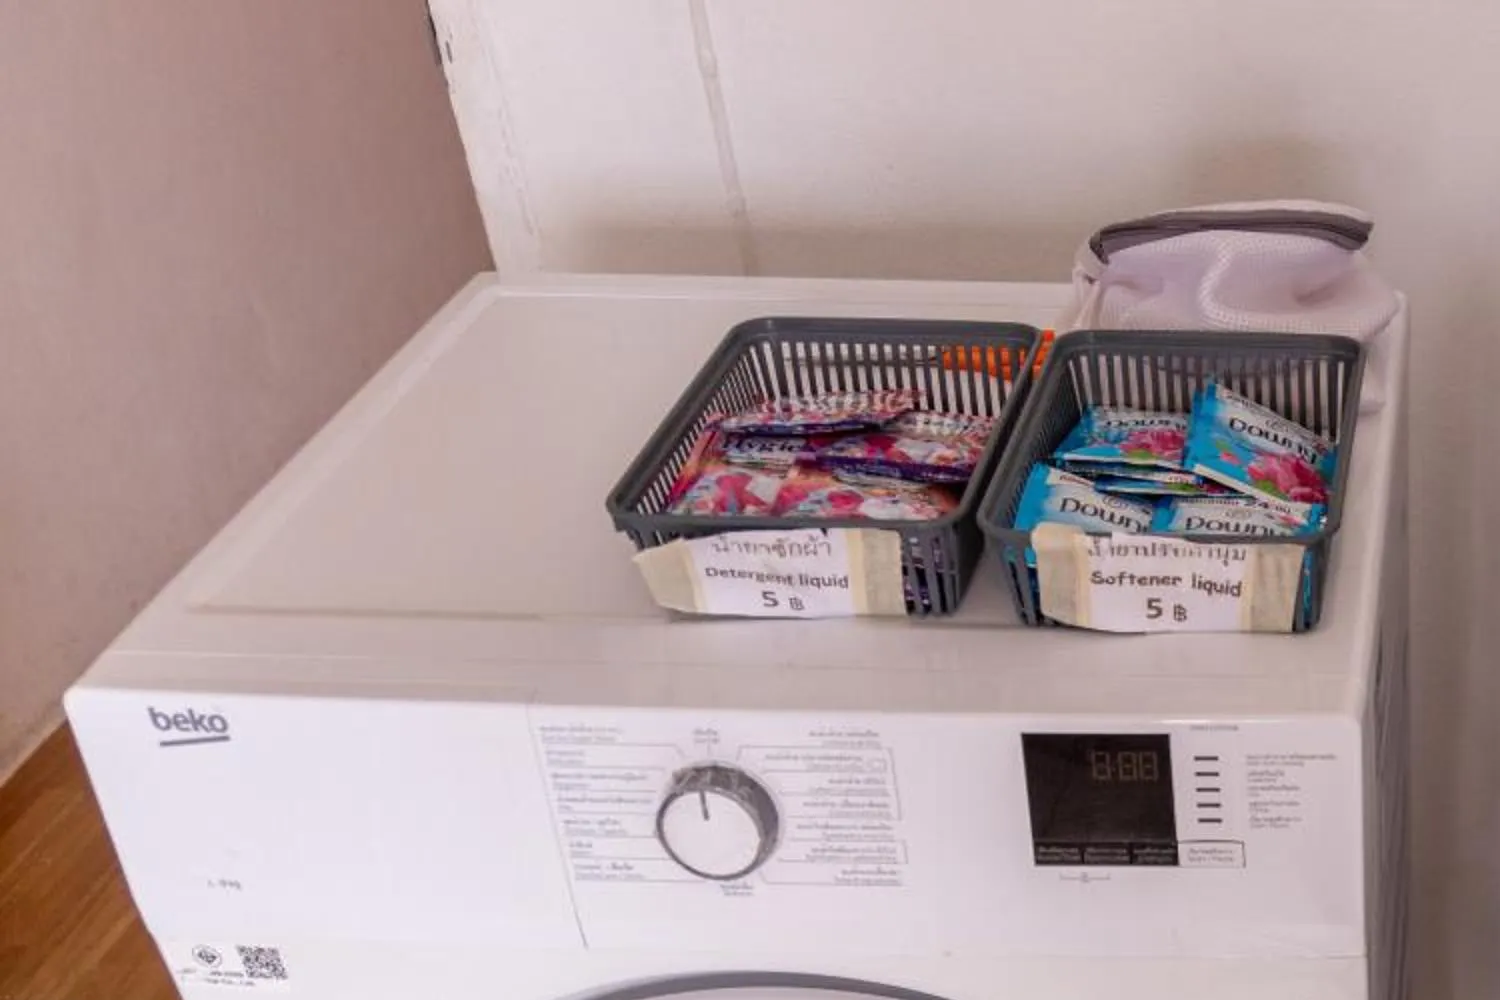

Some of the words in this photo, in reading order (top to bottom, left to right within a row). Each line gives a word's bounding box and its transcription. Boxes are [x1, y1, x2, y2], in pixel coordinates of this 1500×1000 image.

[705, 566, 796, 588] Detergent
[799, 573, 849, 589] liquid
[1090, 571, 1182, 586] Softener
[1191, 573, 1242, 597] liquid
[761, 591, 779, 608] 5
[1146, 598, 1163, 619] 5
[147, 706, 229, 733] beko
